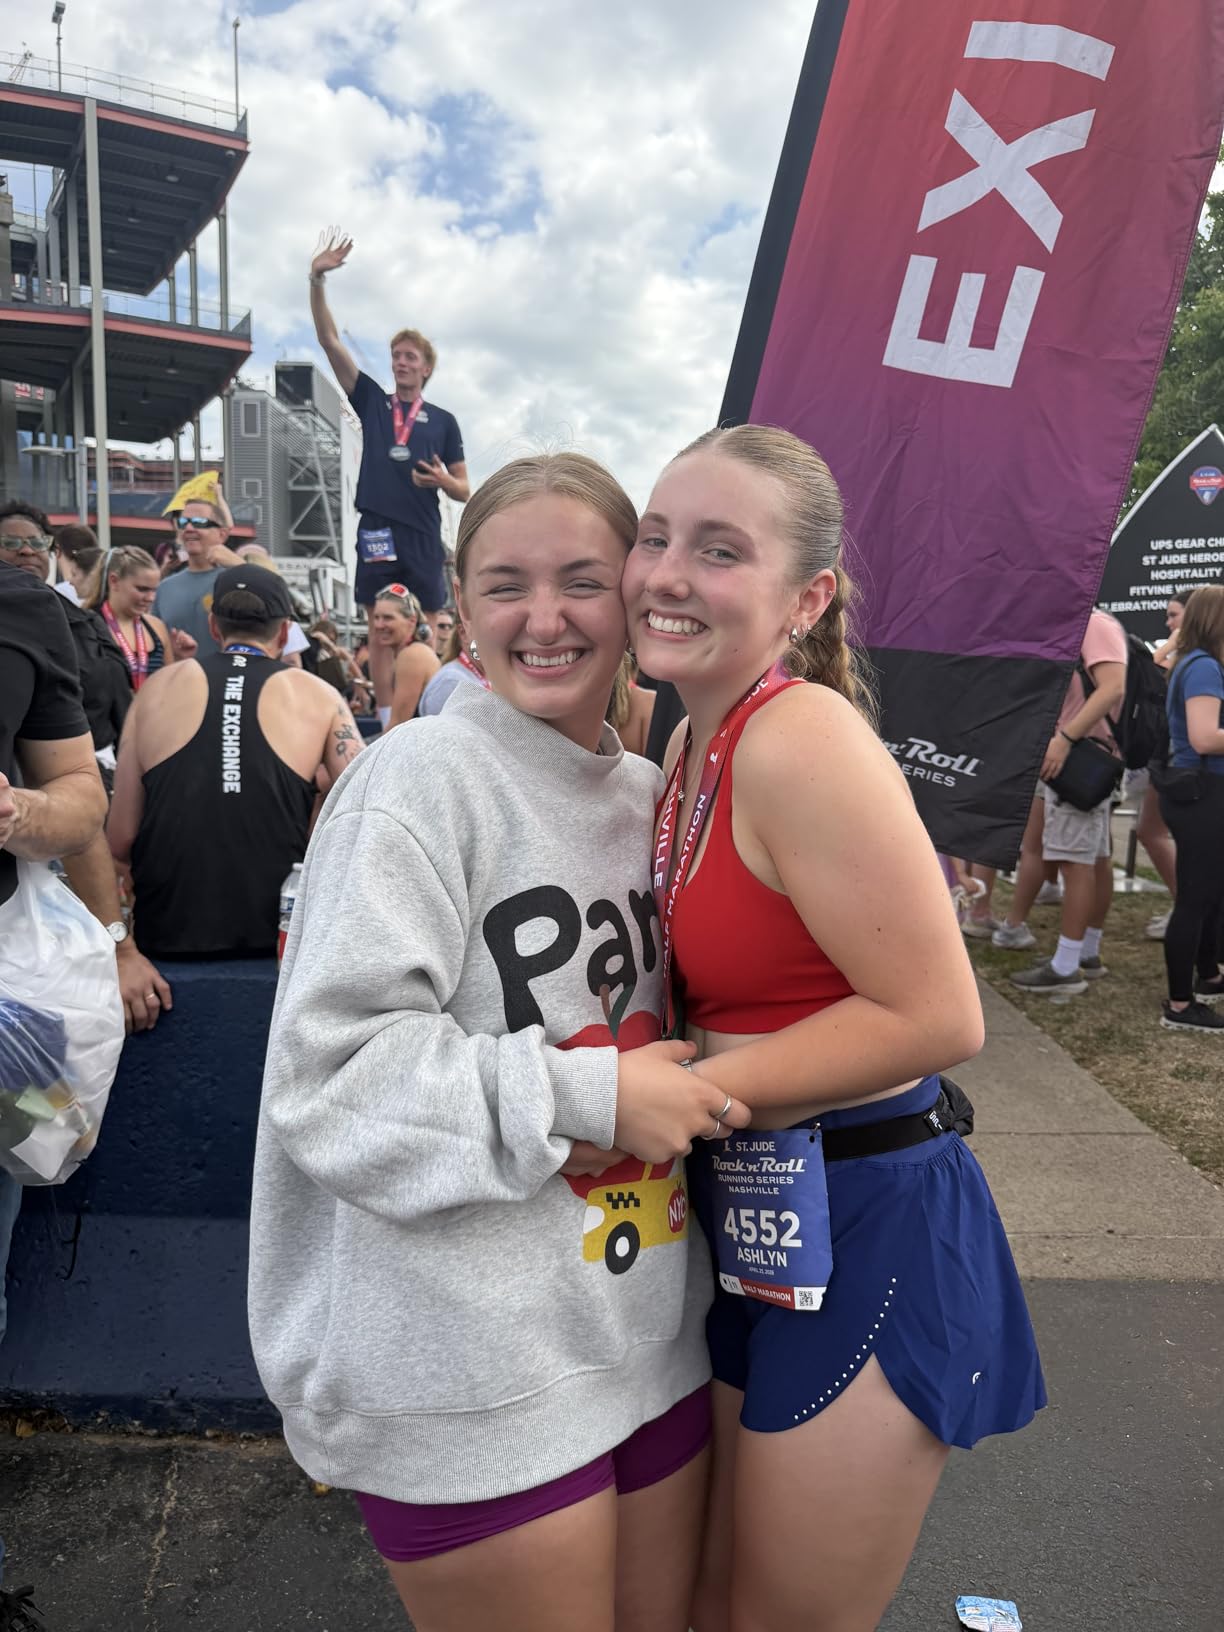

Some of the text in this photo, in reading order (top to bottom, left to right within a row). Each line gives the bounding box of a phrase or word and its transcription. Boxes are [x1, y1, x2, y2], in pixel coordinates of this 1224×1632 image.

[1150, 536, 1224, 550] UPS GEAR CH
[1142, 555, 1158, 566] ST
[1158, 554, 1188, 565] JUDE
[1150, 567, 1222, 580] HOSPITALITY
[1129, 585, 1173, 596] FITVINE
[224, 675, 245, 701] THE
[222, 704, 241, 793] EXCHANGE
[667, 794, 706, 917] MARATHON
[718, 1174, 794, 1184] RUNNING SERIES
[729, 1186, 779, 1194] NASHVILLE
[669, 1194, 687, 1227] NYC
[724, 1207, 802, 1248] 4552
[737, 1246, 788, 1268] ASHLYN
[757, 1287, 792, 1302] MARATHON
